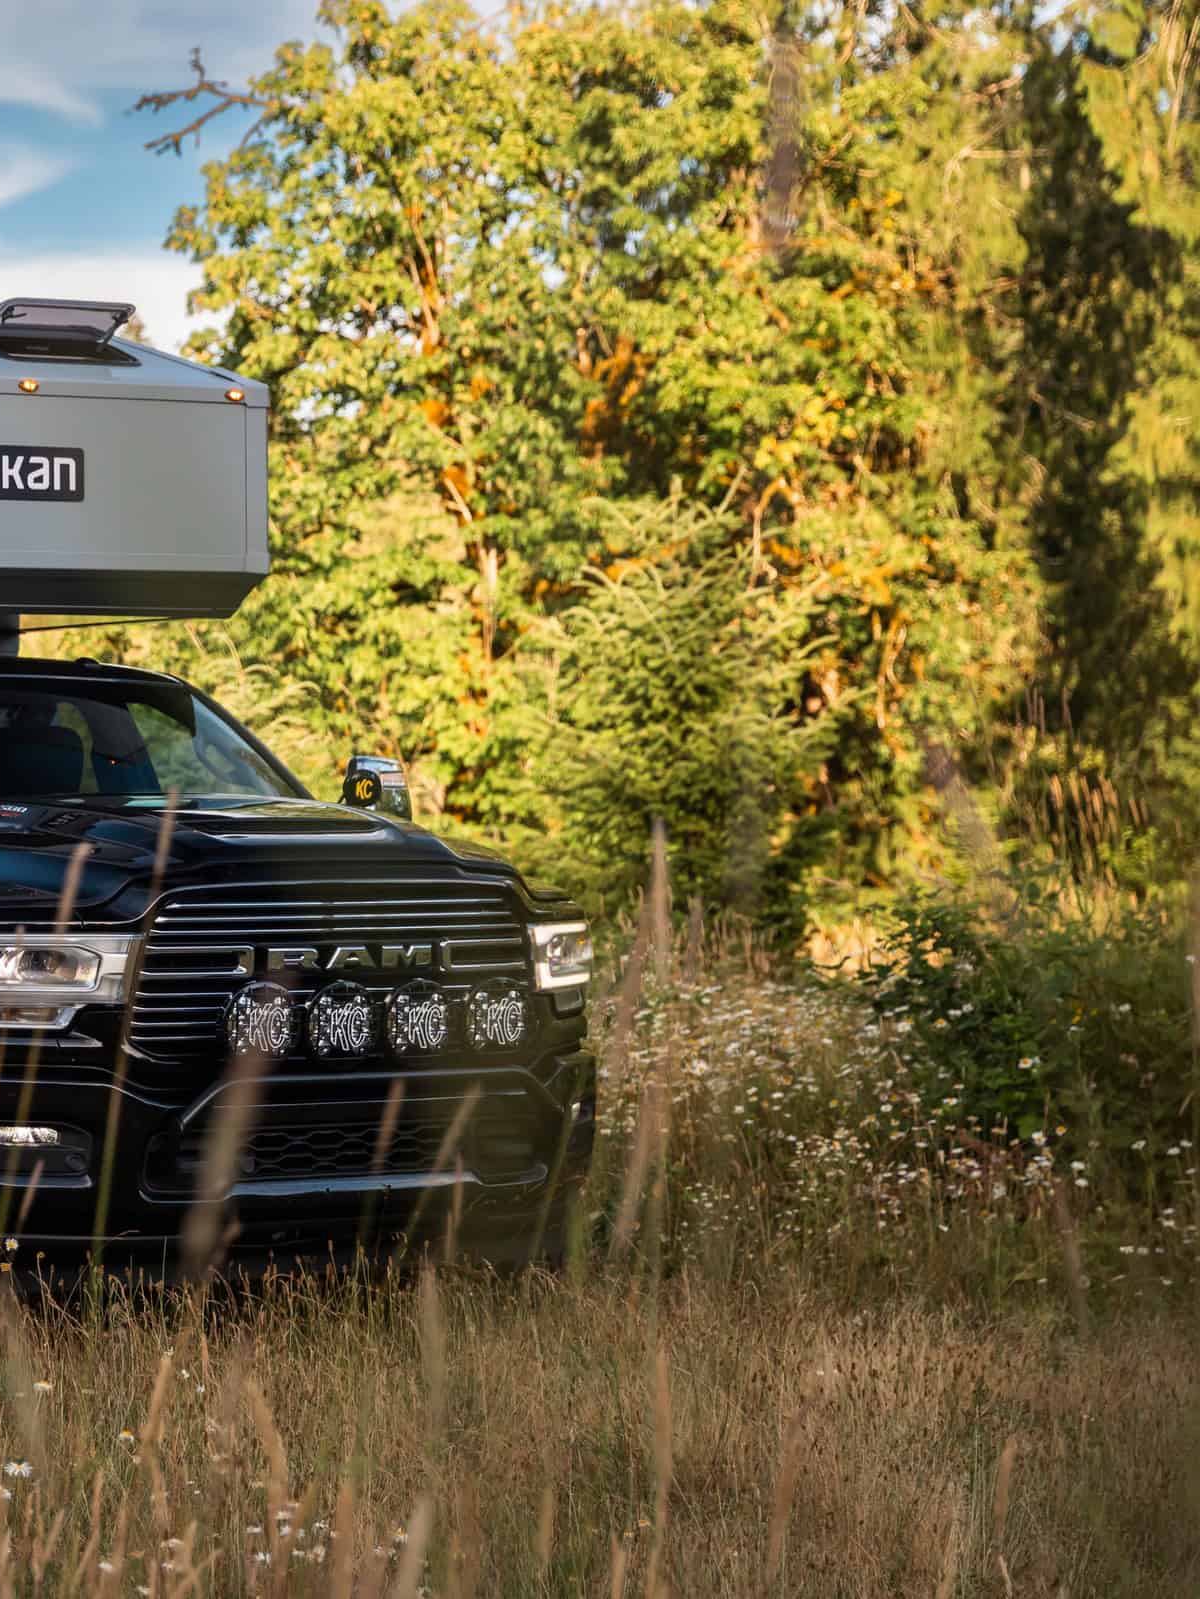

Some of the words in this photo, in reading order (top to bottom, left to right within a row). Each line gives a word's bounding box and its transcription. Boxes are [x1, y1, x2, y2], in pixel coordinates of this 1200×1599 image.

[355, 778, 374, 800] KC
[266, 945, 433, 971] RAM
[249, 1002, 288, 1051] KC
[330, 1002, 368, 1051] KC
[408, 1001, 444, 1048] KC
[487, 998, 522, 1045] KC
